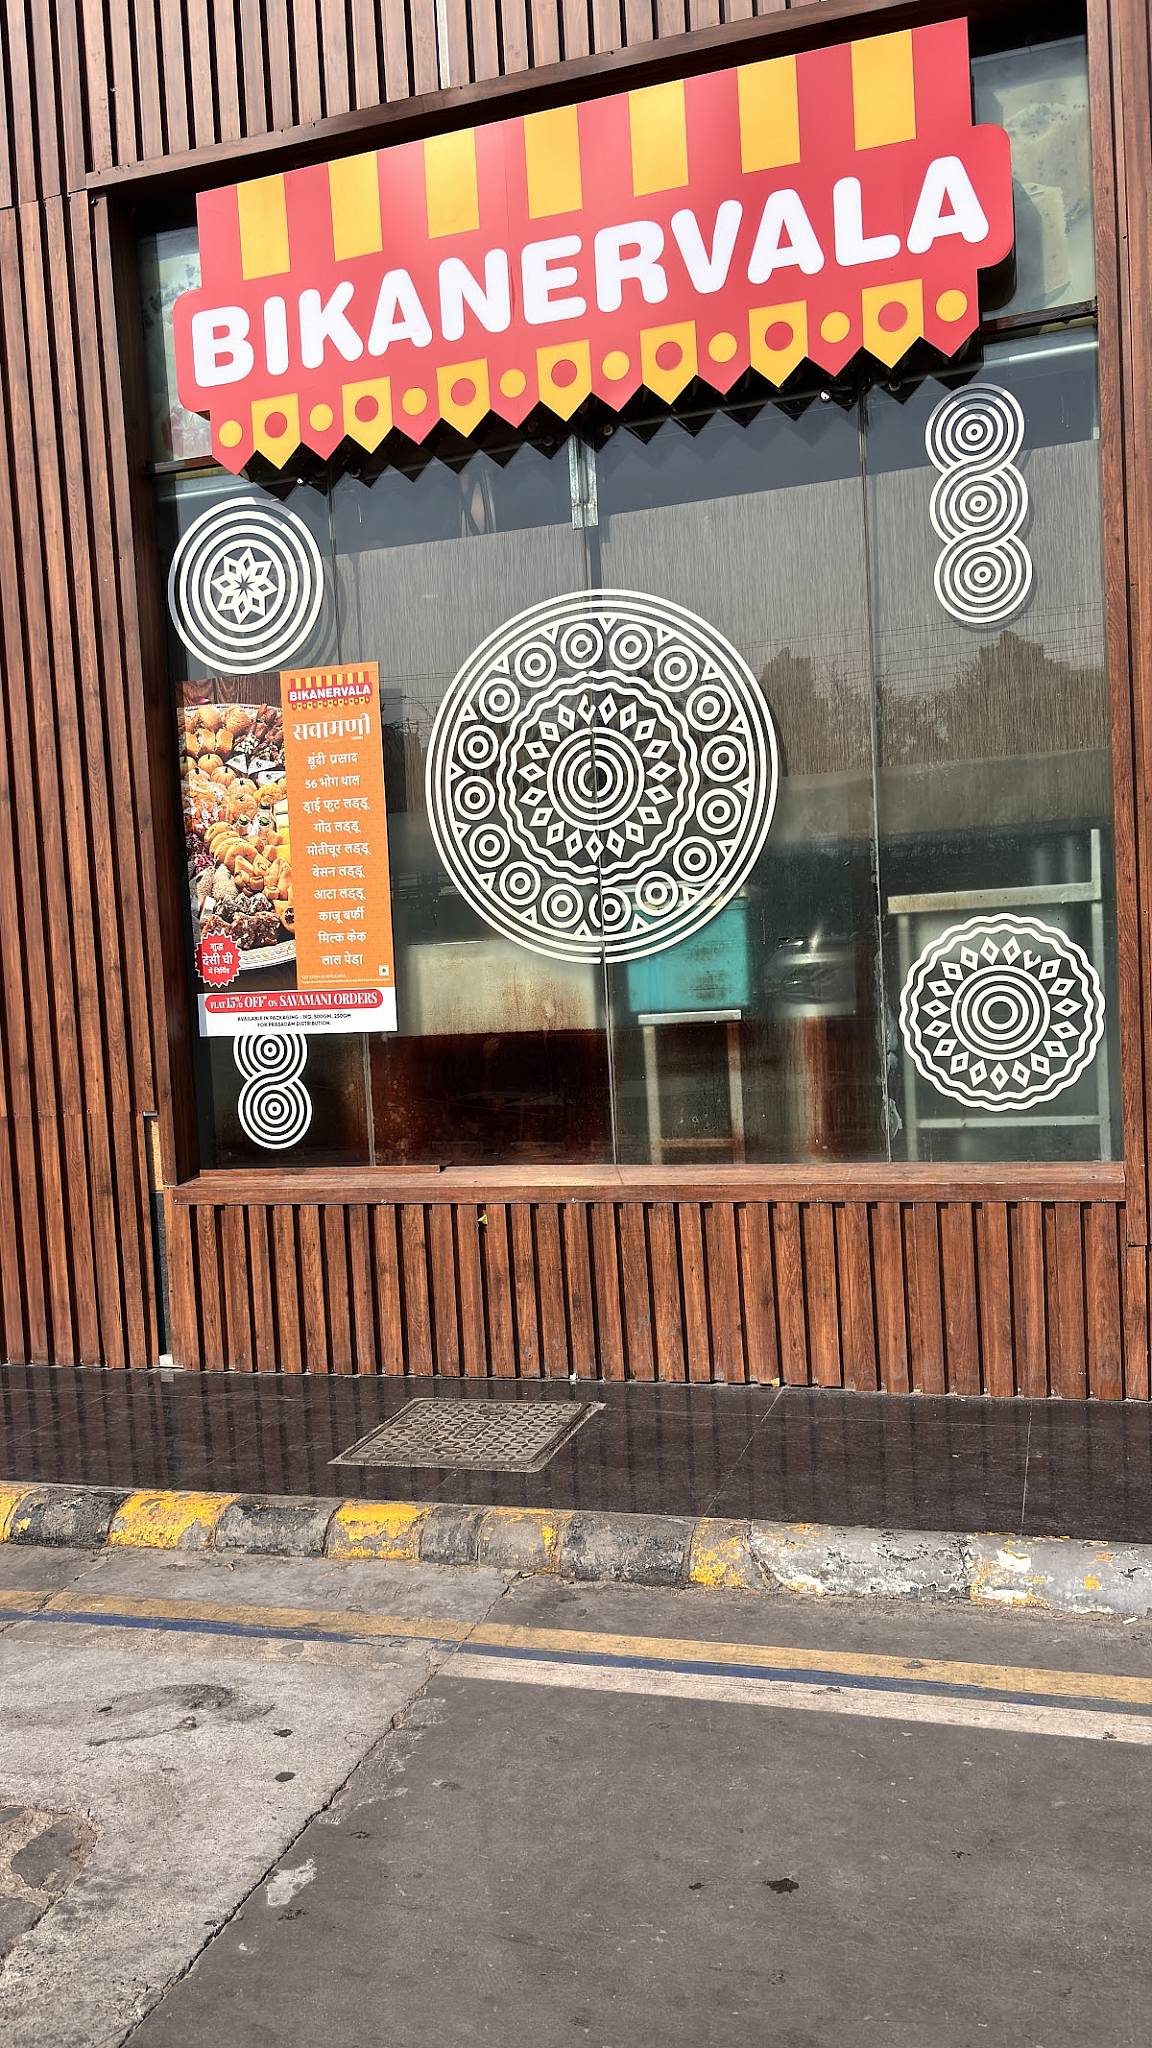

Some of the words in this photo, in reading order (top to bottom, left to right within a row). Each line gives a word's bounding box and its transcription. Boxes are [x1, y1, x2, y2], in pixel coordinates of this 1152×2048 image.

[190, 155, 990, 388] BIKANERVALA
[289, 684, 371, 702] BIKANERVALA
[291, 712, 372, 741] सवामणी
[330, 752, 359, 765] प्रसाद
[305, 780, 317, 789] 56
[320, 774, 338, 788] भोग
[306, 843, 342, 857] मोतीचूर
[314, 888, 337, 900] आटा
[318, 910, 344, 924] काजू
[317, 930, 345, 944] मिल्क
[346, 929, 368, 942] केक
[202, 952, 220, 966] देसी
[320, 955, 342, 966] लाल
[210, 1001, 226, 1009] FLAT
[226, 996, 244, 1009] 15%
[279, 993, 332, 1007] SAVAMANI
[333, 992, 378, 1005] ORDERS
